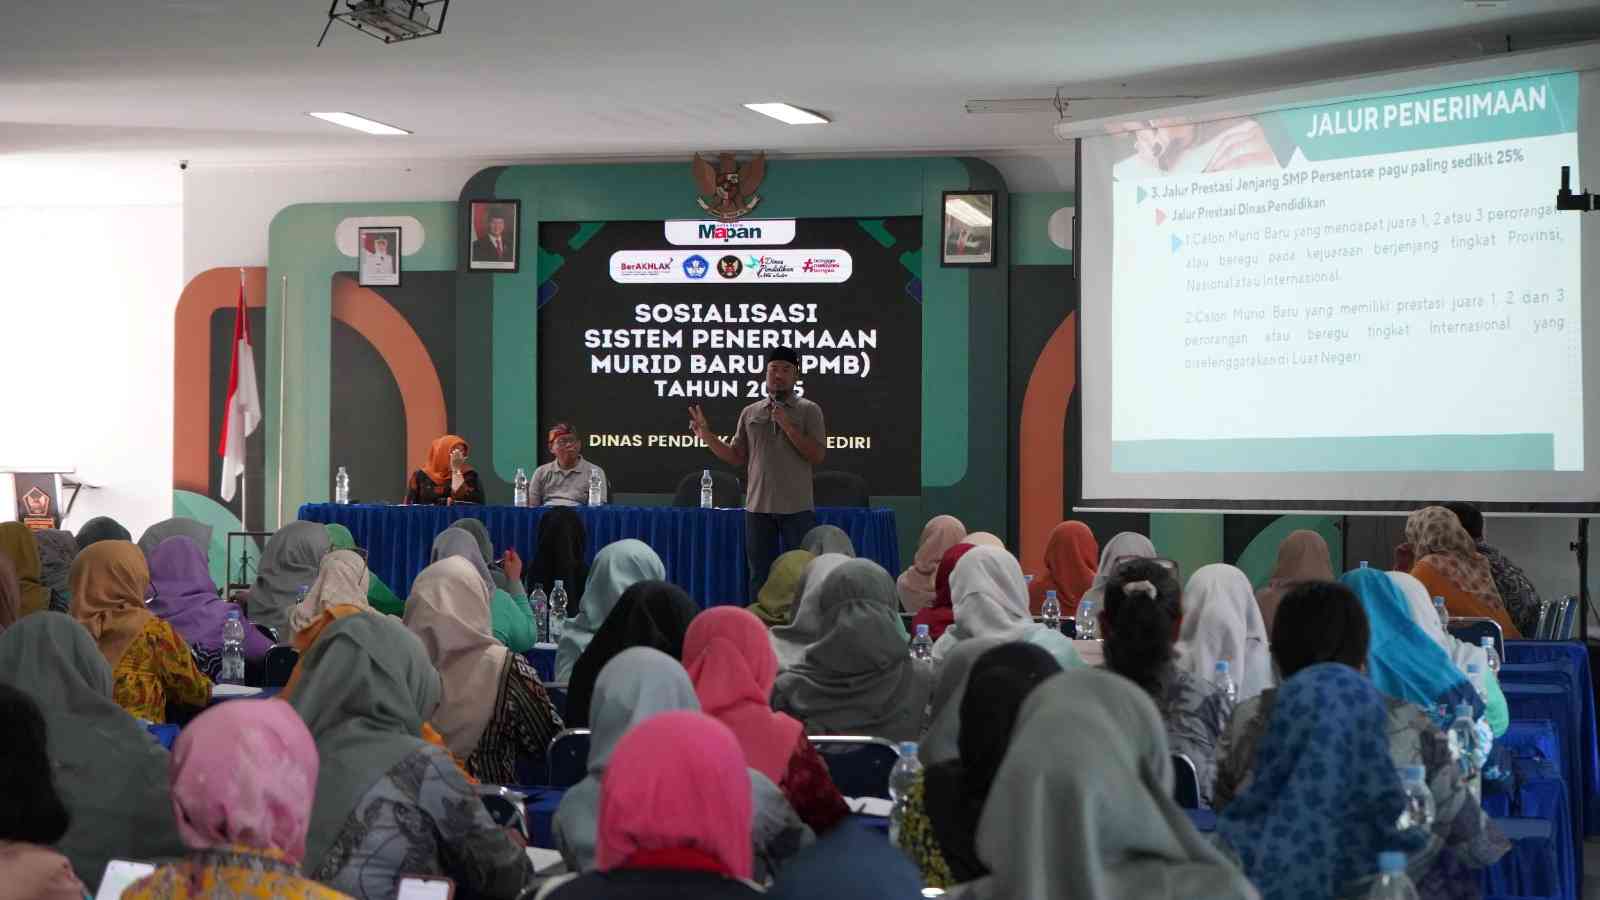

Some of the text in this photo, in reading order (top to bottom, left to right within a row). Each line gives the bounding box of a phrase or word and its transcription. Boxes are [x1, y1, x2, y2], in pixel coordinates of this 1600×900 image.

[1306, 85, 1547, 138] JALUR PENERIMAAN
[1162, 184, 1189, 199] Jalur
[1191, 179, 1233, 195] Prestasi
[1236, 176, 1280, 192] Jenjang
[1282, 172, 1308, 186] SMP
[1311, 167, 1375, 183] Persentase
[1378, 167, 1409, 181] pagu
[1411, 159, 1448, 176] paling
[1451, 152, 1494, 169] sedikit
[1496, 149, 1525, 164] 25%
[1171, 197, 1327, 222] Jalur Prestasi Dinas Pendidikan
[1475, 207, 1483, 222] 3
[698, 223, 762, 242] Mapan
[1450, 232, 1497, 250] tingkat
[620, 261, 673, 271] BerAKHLAK
[634, 303, 818, 323] SOSIALISASI
[584, 328, 878, 350] SISTEM PENERIMAAN
[591, 353, 682, 374] MURID
[690, 353, 765, 375] BARU
[654, 379, 738, 398] TAHUN
[589, 434, 643, 447] DINAS
